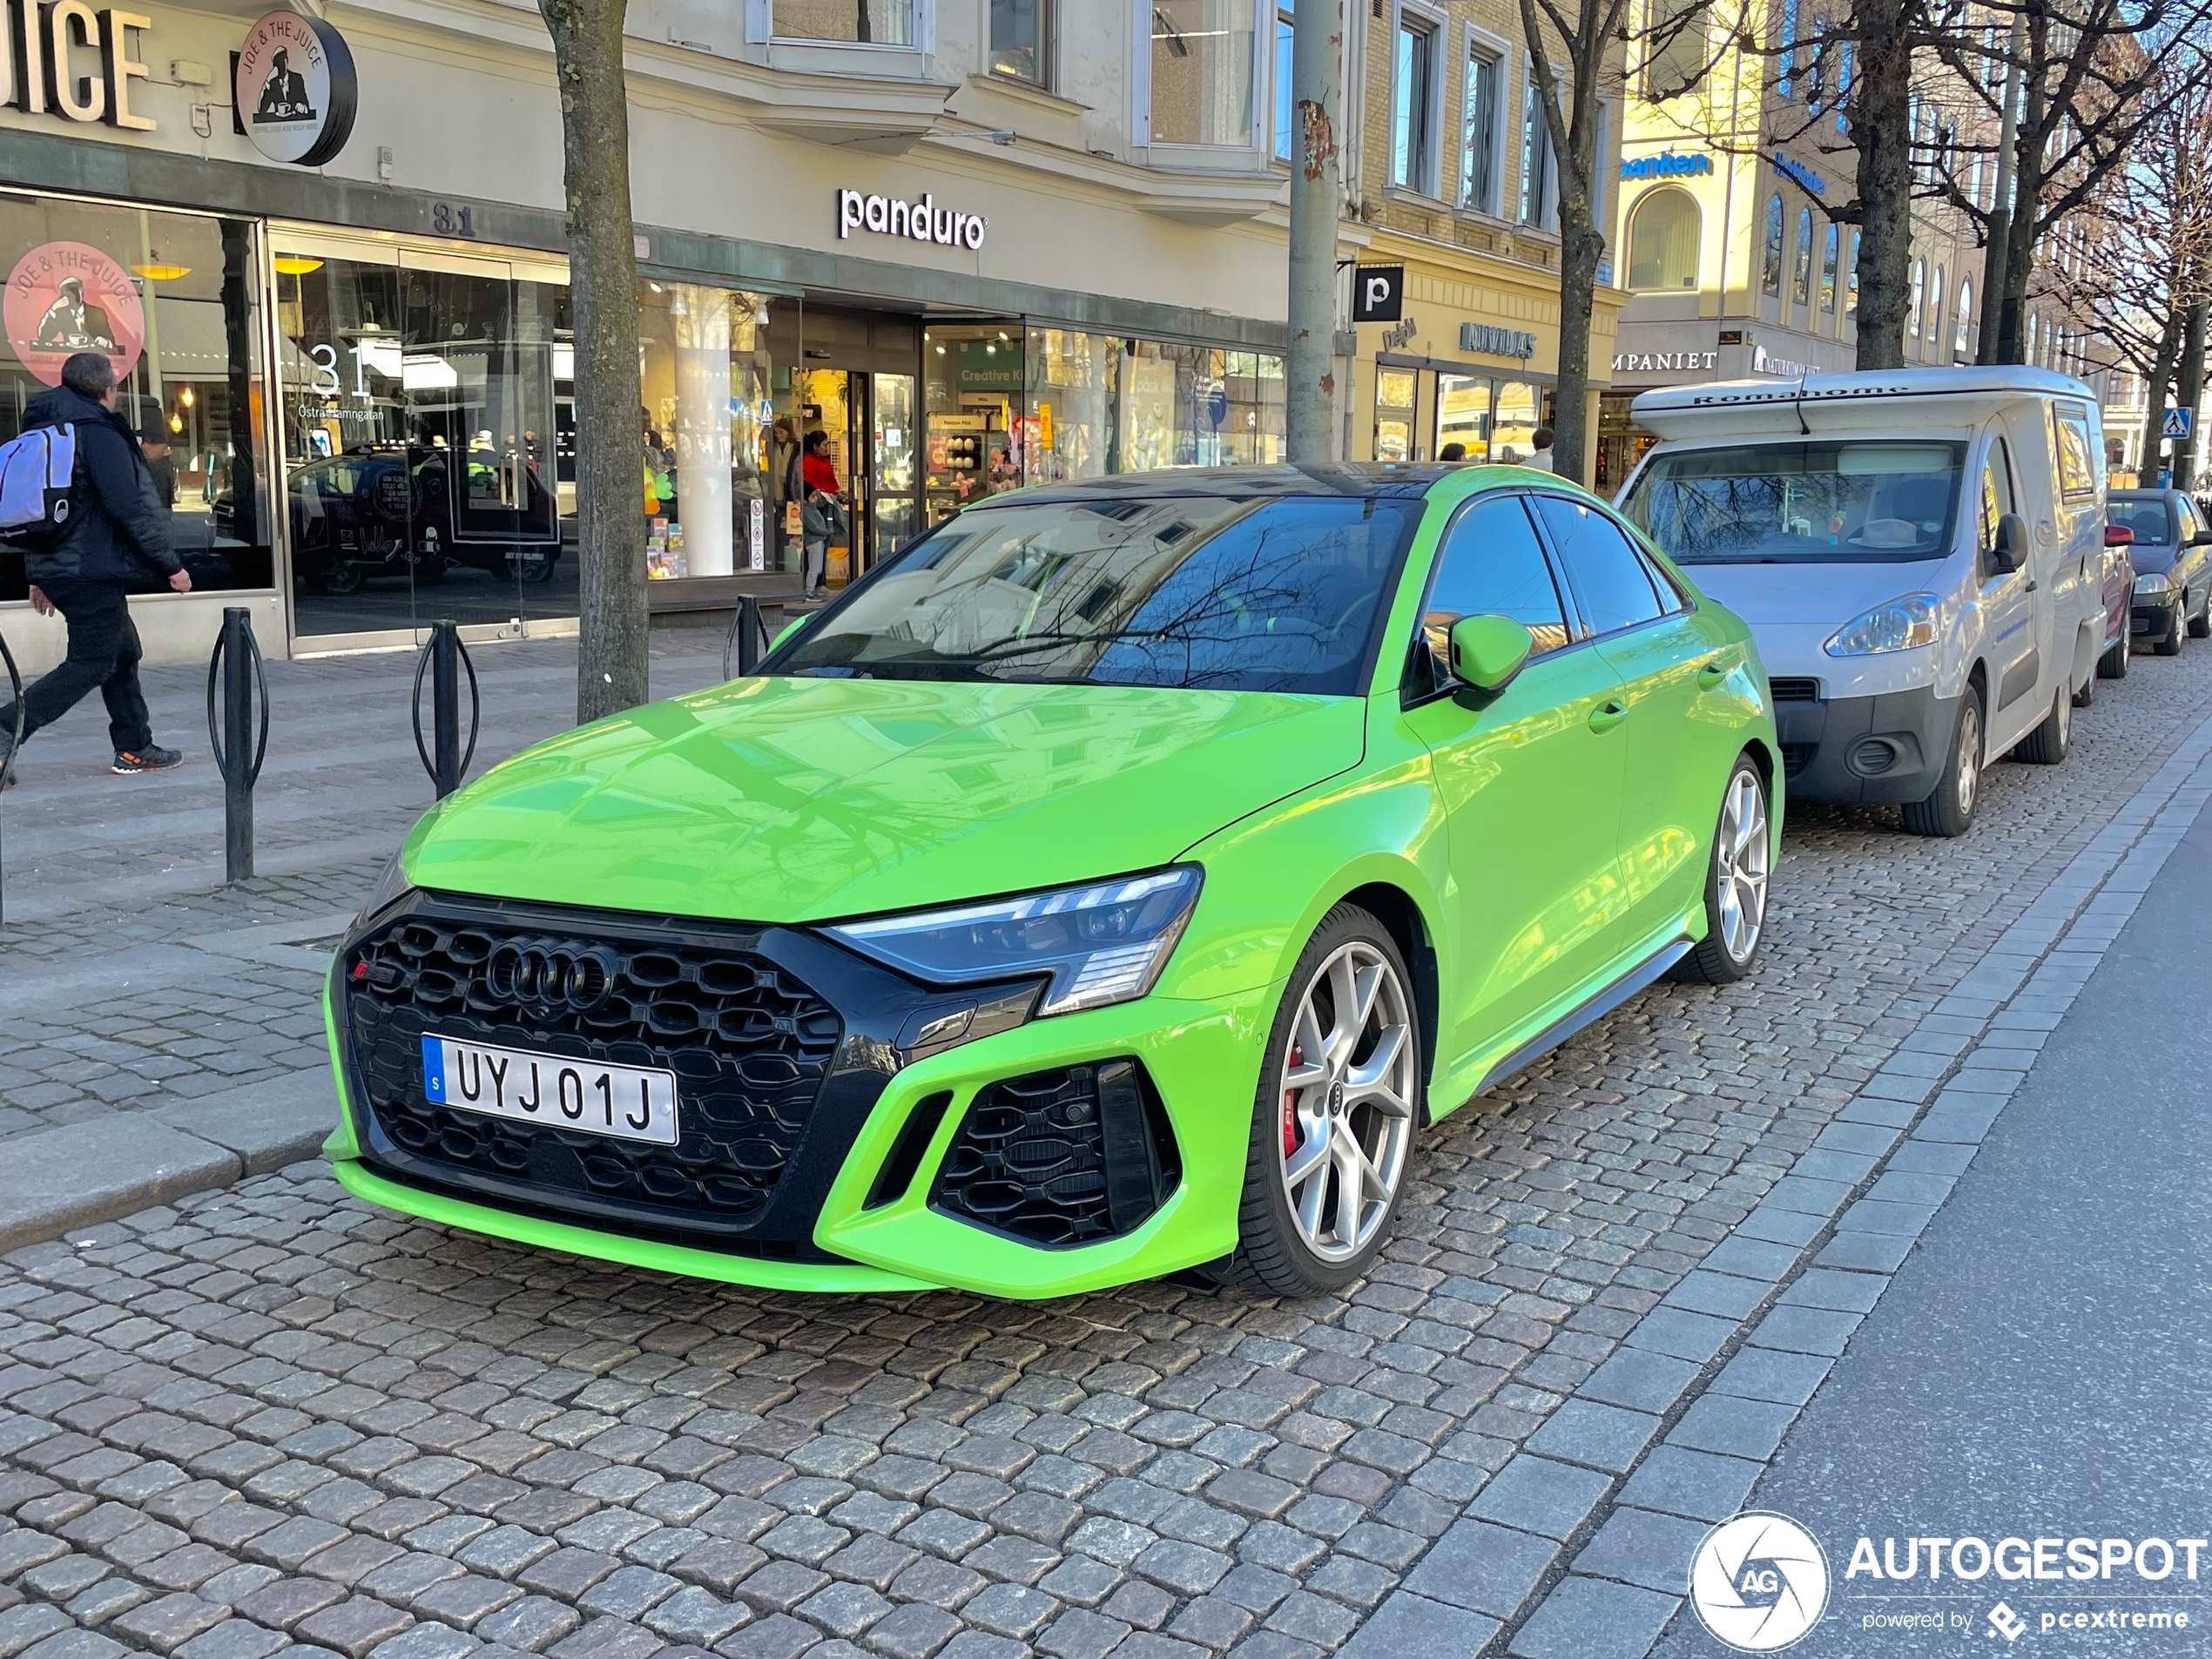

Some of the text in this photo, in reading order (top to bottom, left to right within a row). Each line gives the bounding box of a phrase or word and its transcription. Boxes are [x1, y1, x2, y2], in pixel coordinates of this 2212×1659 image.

[0, 0, 157, 131] ICE
[243, 20, 323, 75] JOE & THE JUICE
[434, 201, 476, 237] 31
[14, 250, 133, 308] JOE & THE JUICE
[1365, 277, 1391, 312] p
[310, 343, 370, 398] 31
[961, 369, 1010, 382] Creative
[1693, 386, 1910, 405] Romahome
[431, 1076, 440, 1090] S
